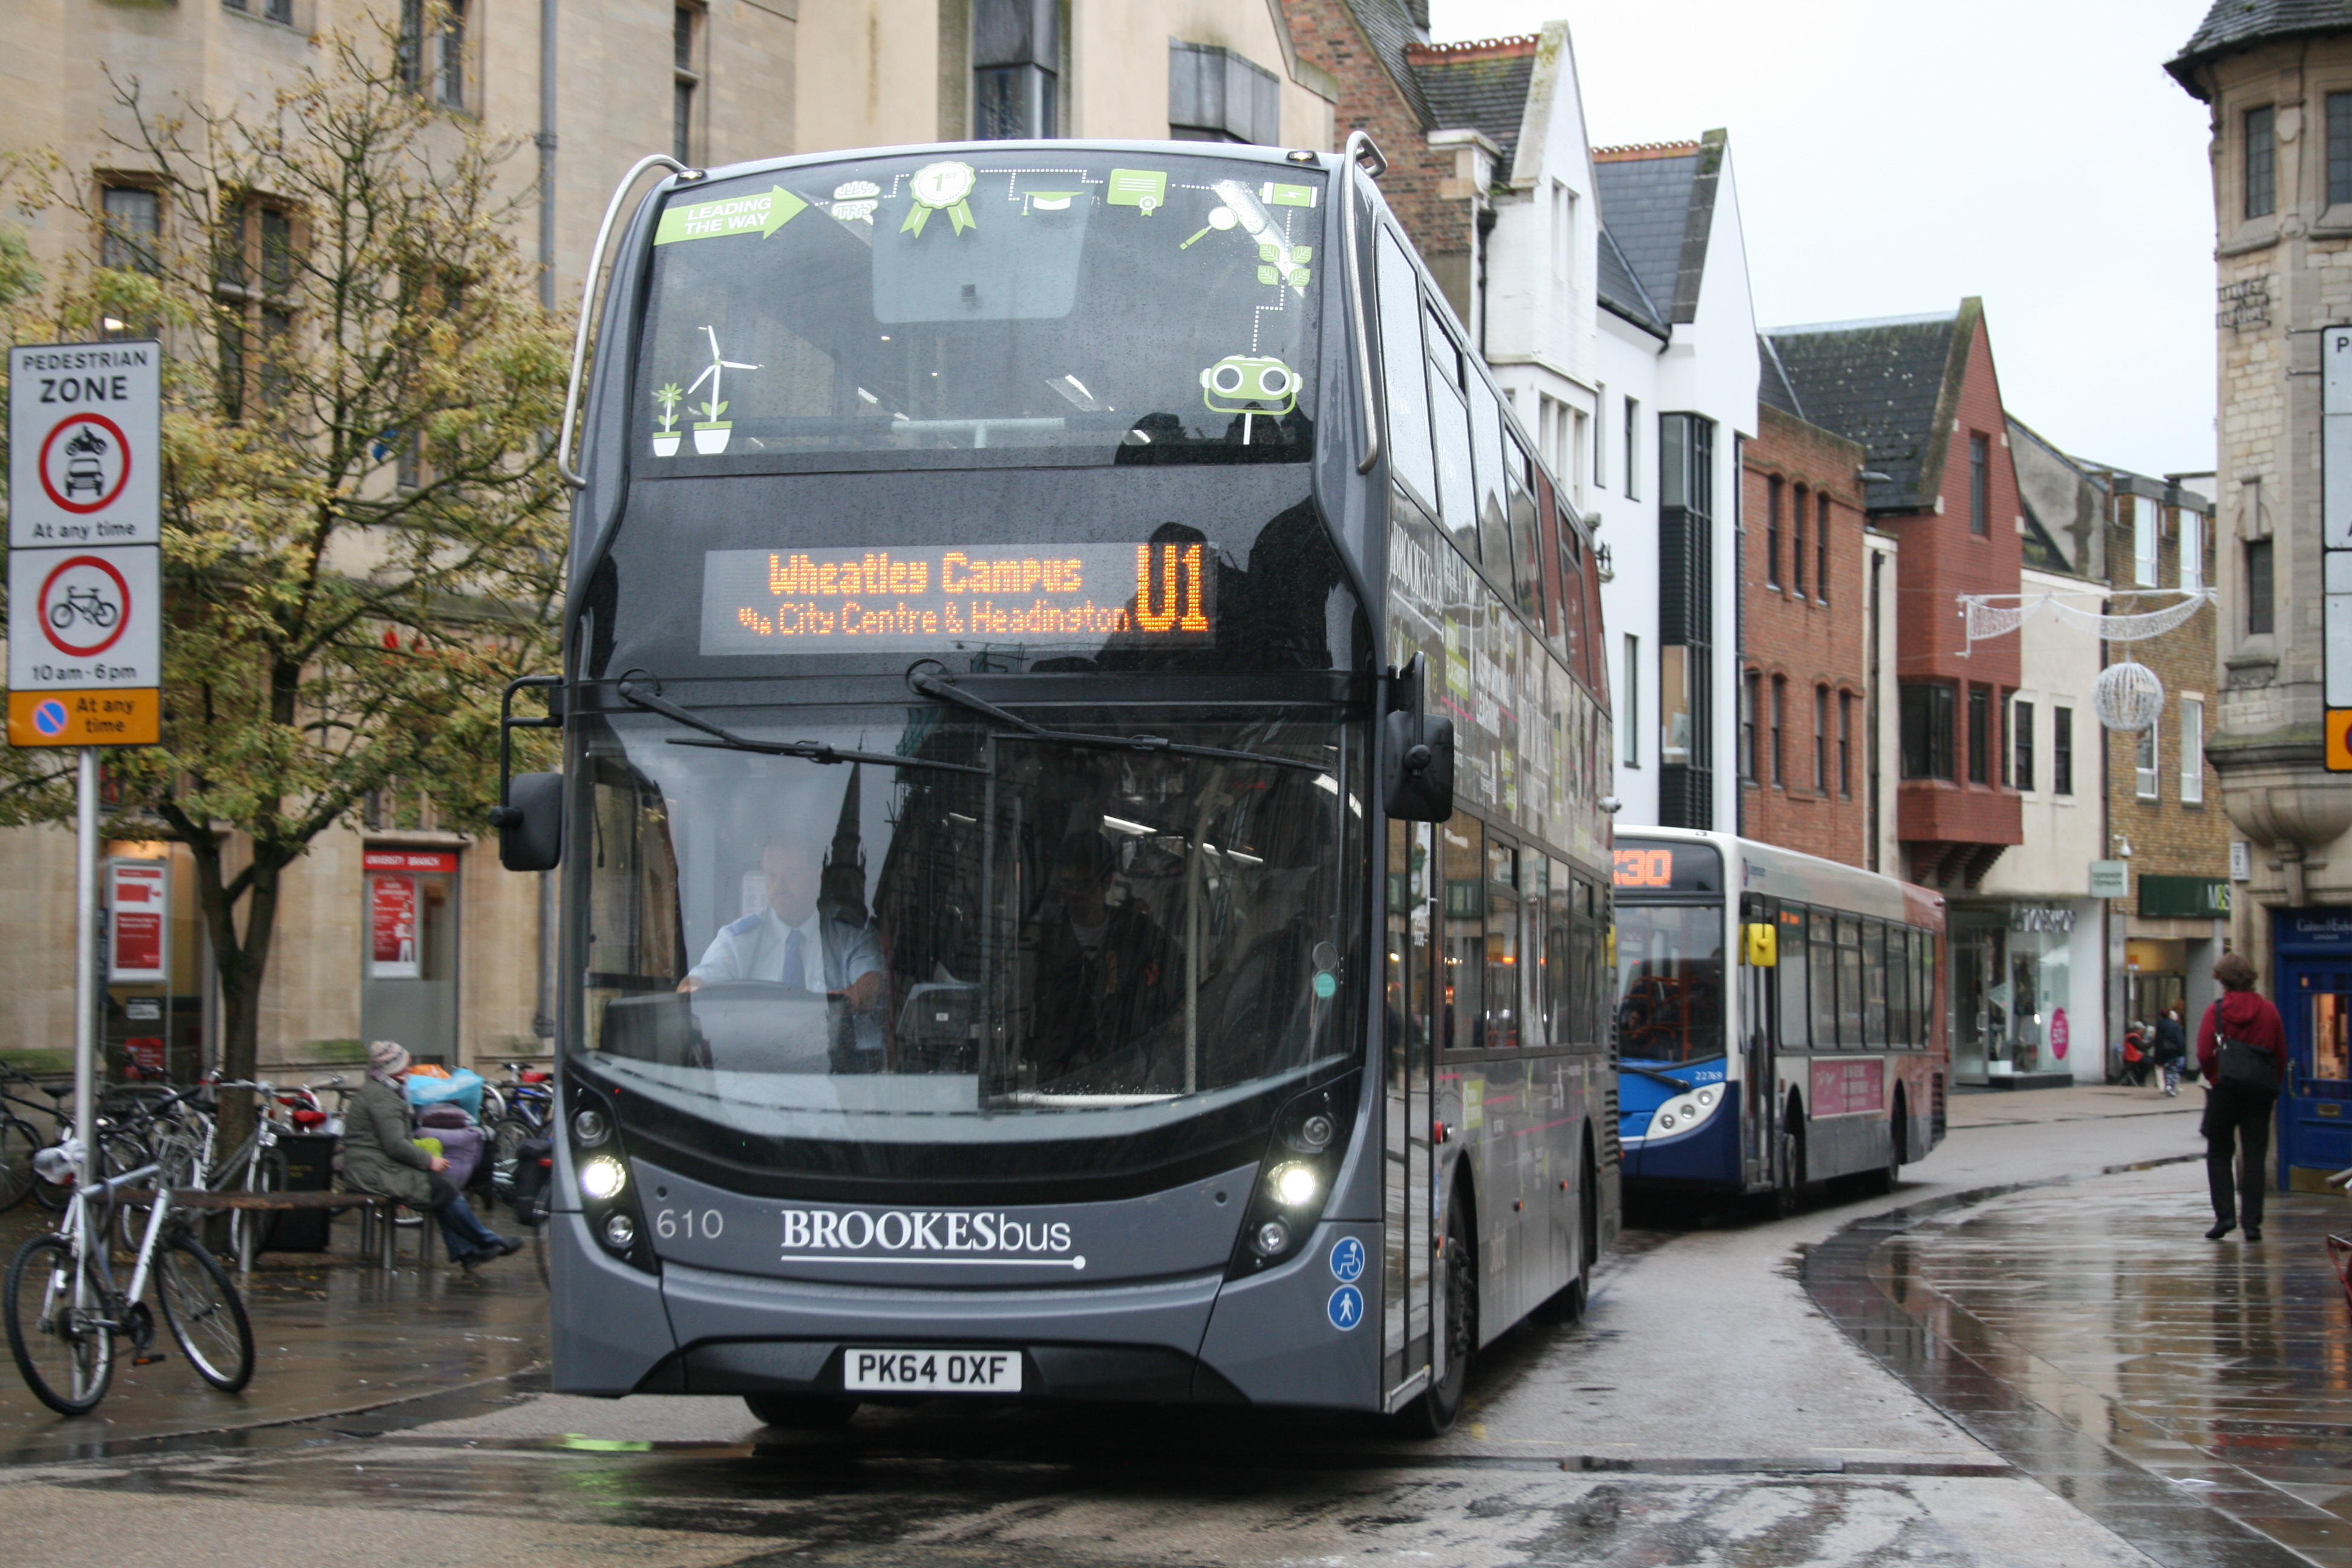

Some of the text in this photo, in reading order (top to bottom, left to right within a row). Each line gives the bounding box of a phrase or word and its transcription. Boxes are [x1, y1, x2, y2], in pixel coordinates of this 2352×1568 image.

[932, 172, 958, 192] 1ST
[687, 197, 772, 221] LEADING
[684, 212, 771, 235] THE WAY
[22, 351, 148, 370] PEDESTRIAN
[40, 376, 128, 403] ZONE
[33, 521, 137, 540] At any time
[769, 544, 1208, 632] Wheatley Campus U1
[779, 601, 835, 633] City
[841, 601, 938, 633] Centre
[945, 601, 964, 633] &
[970, 599, 1132, 633] Headington
[76, 697, 136, 715] At any
[85, 717, 126, 733] time
[656, 1208, 724, 1240] 610
[781, 1209, 1072, 1252] BROOKESbus
[858, 1354, 1007, 1384] PK64 OXF
